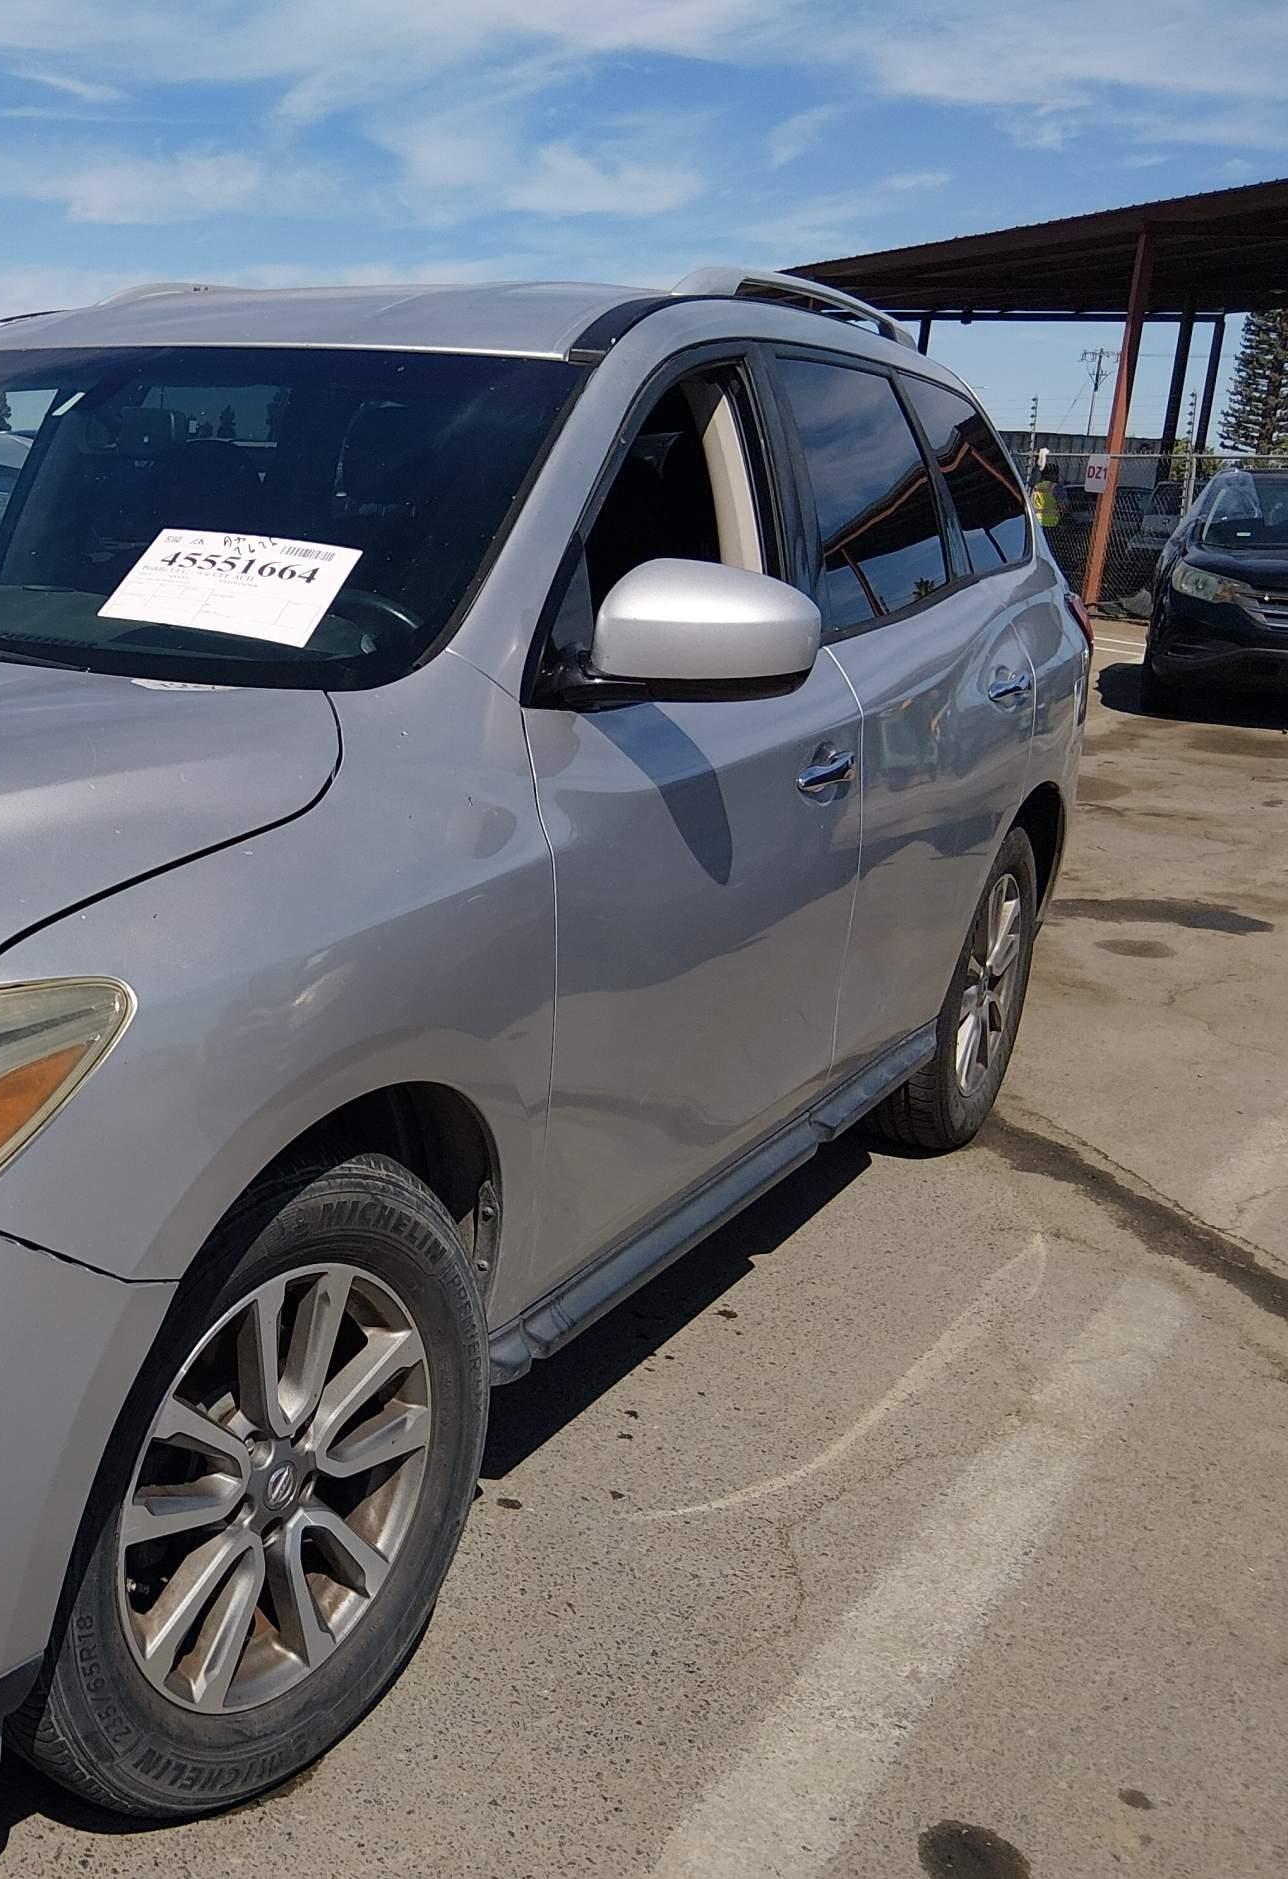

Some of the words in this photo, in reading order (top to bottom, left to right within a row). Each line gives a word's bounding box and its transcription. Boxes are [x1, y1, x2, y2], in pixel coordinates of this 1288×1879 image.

[160, 551, 320, 583] 45551664
[321, 1200, 447, 1266] MICHELIN
[132, 1746, 285, 1791] MICHELIN
